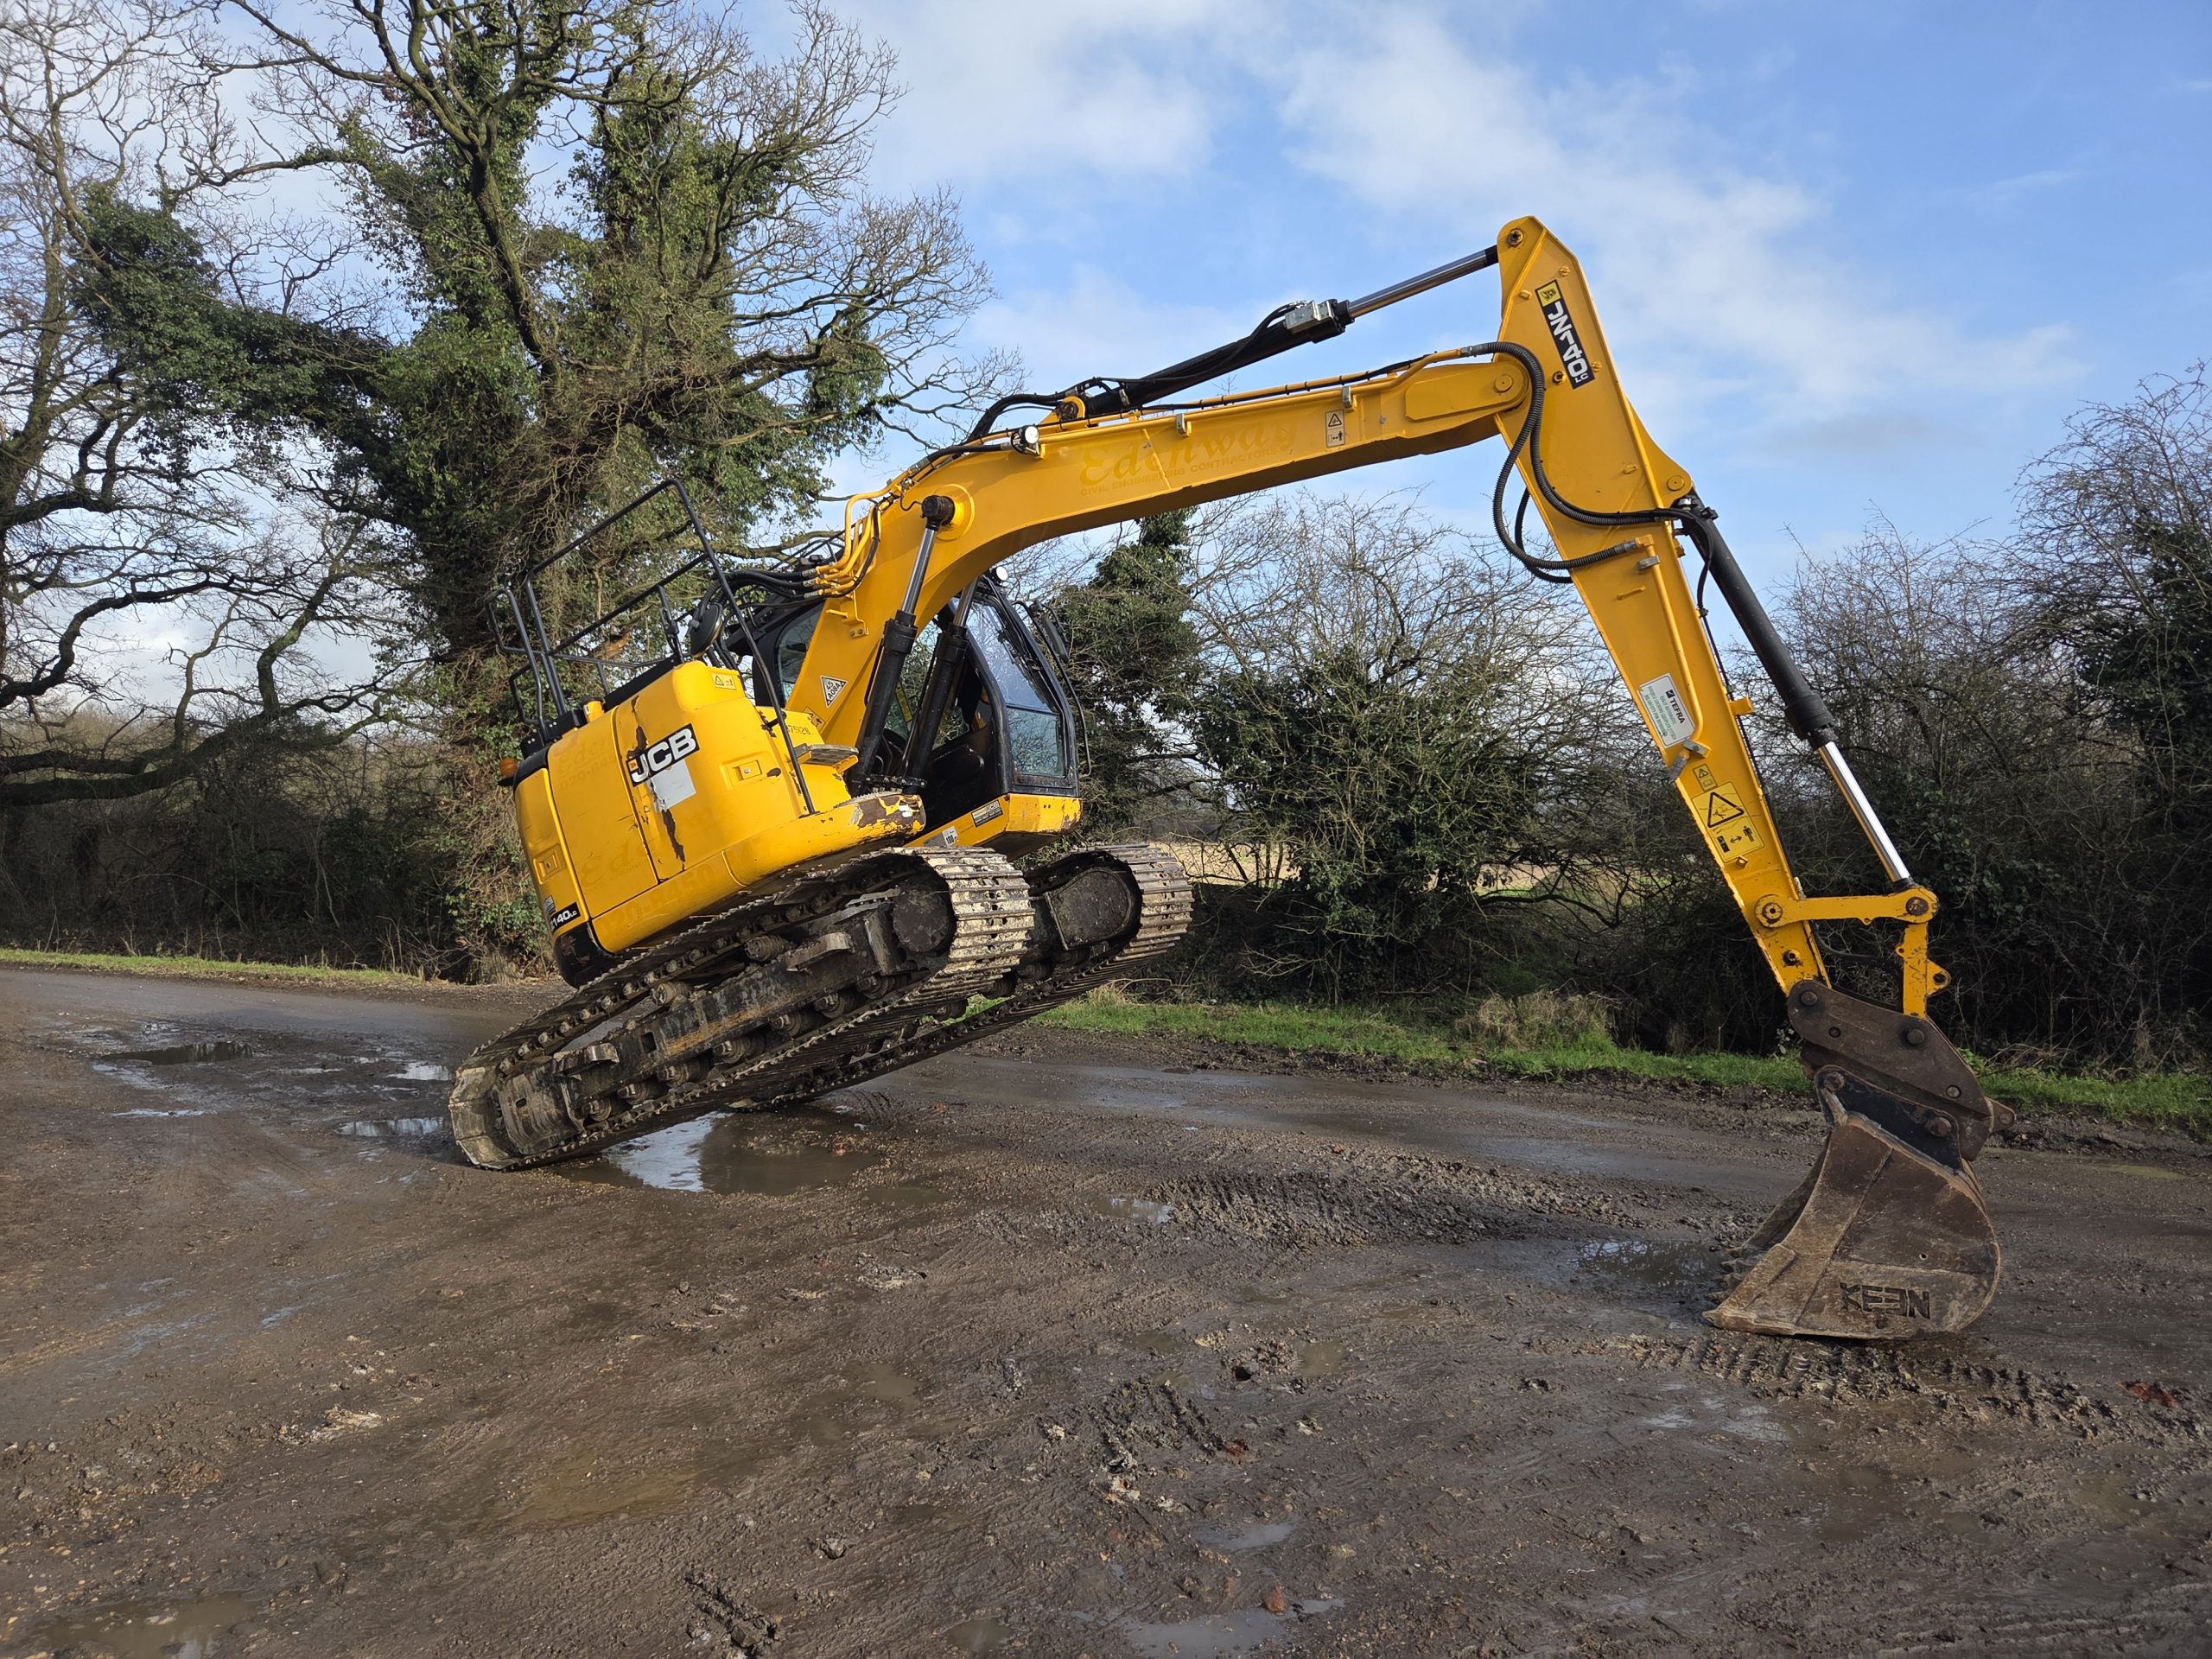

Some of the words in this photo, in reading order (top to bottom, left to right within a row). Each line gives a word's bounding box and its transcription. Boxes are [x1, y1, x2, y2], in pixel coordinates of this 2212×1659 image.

[1112, 467, 1185, 489] ENGINEEING
[1669, 698, 1686, 724] TEFRA
[632, 727, 696, 783] JCB
